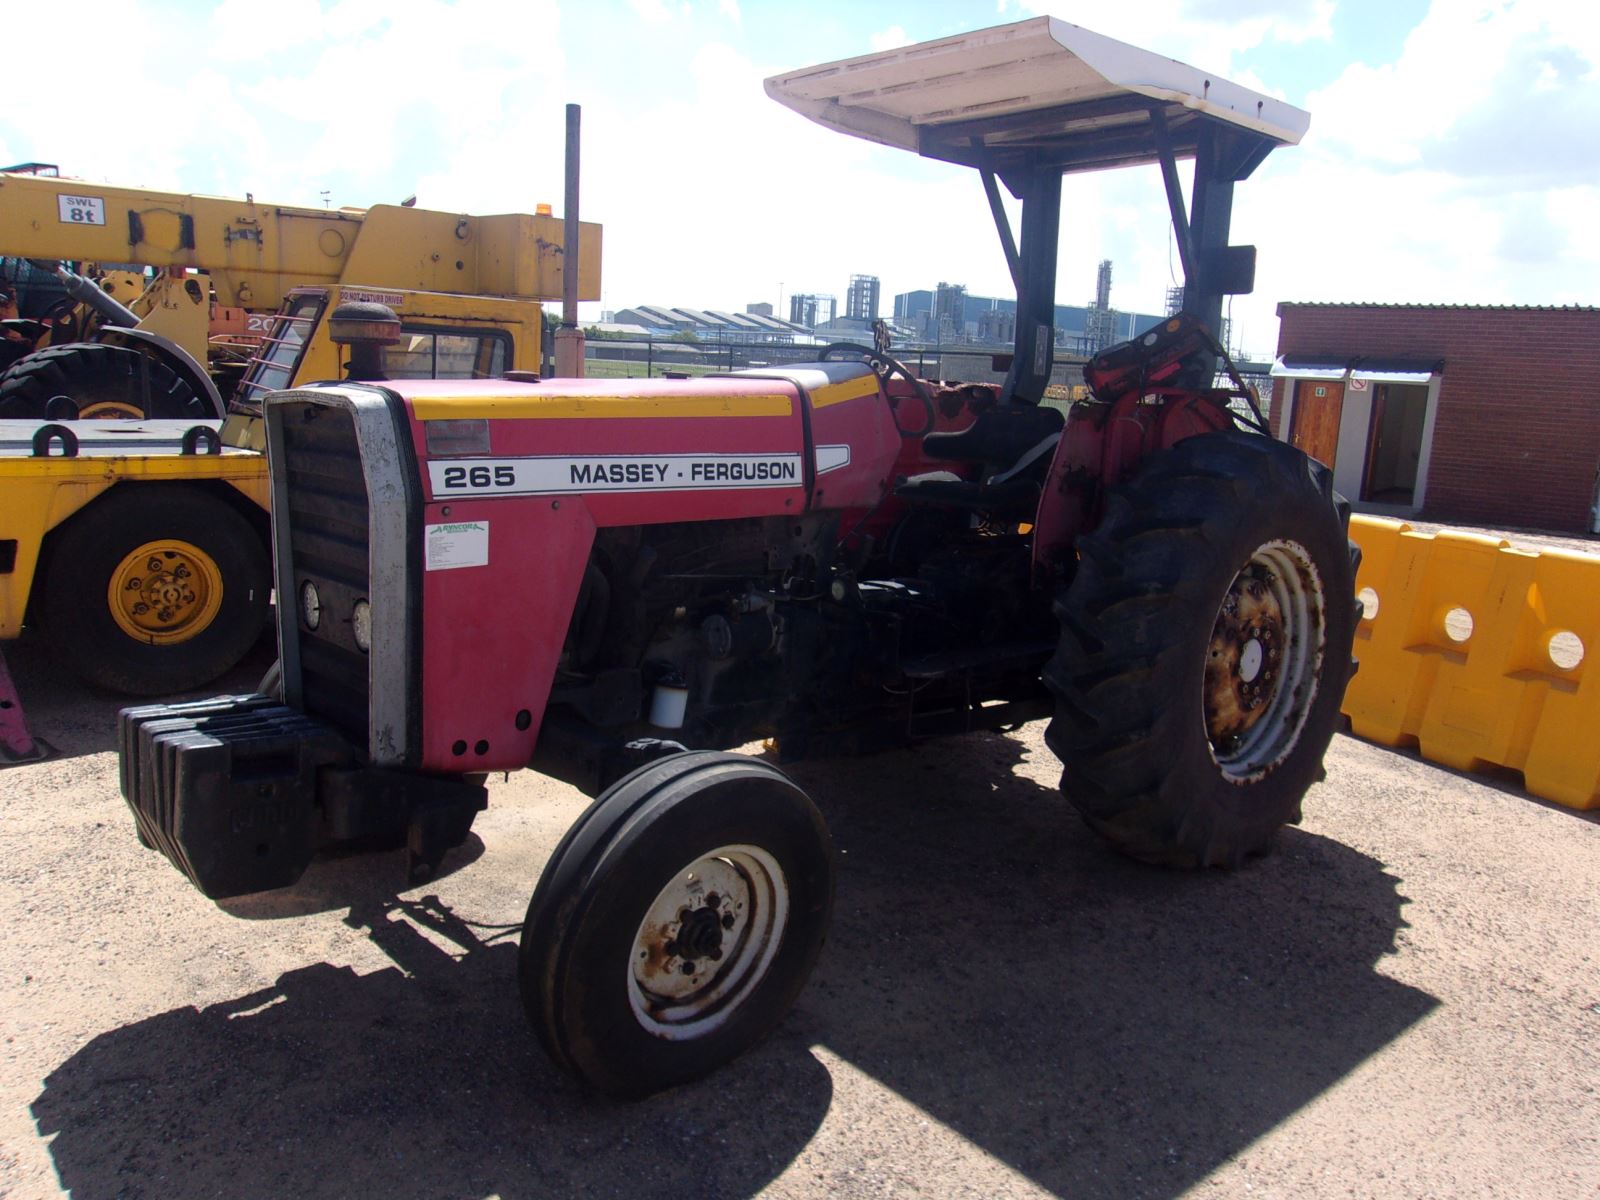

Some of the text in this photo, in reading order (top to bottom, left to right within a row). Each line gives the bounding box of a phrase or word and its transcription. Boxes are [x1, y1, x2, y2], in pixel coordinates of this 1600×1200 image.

[66, 197, 96, 207] SWL
[70, 207, 95, 223] 8t
[340, 291, 348, 300] DO
[350, 292, 360, 301] NOT
[385, 295, 403, 304] DRIVER
[444, 462, 795, 488] 265 MASSEY FERGUSON
